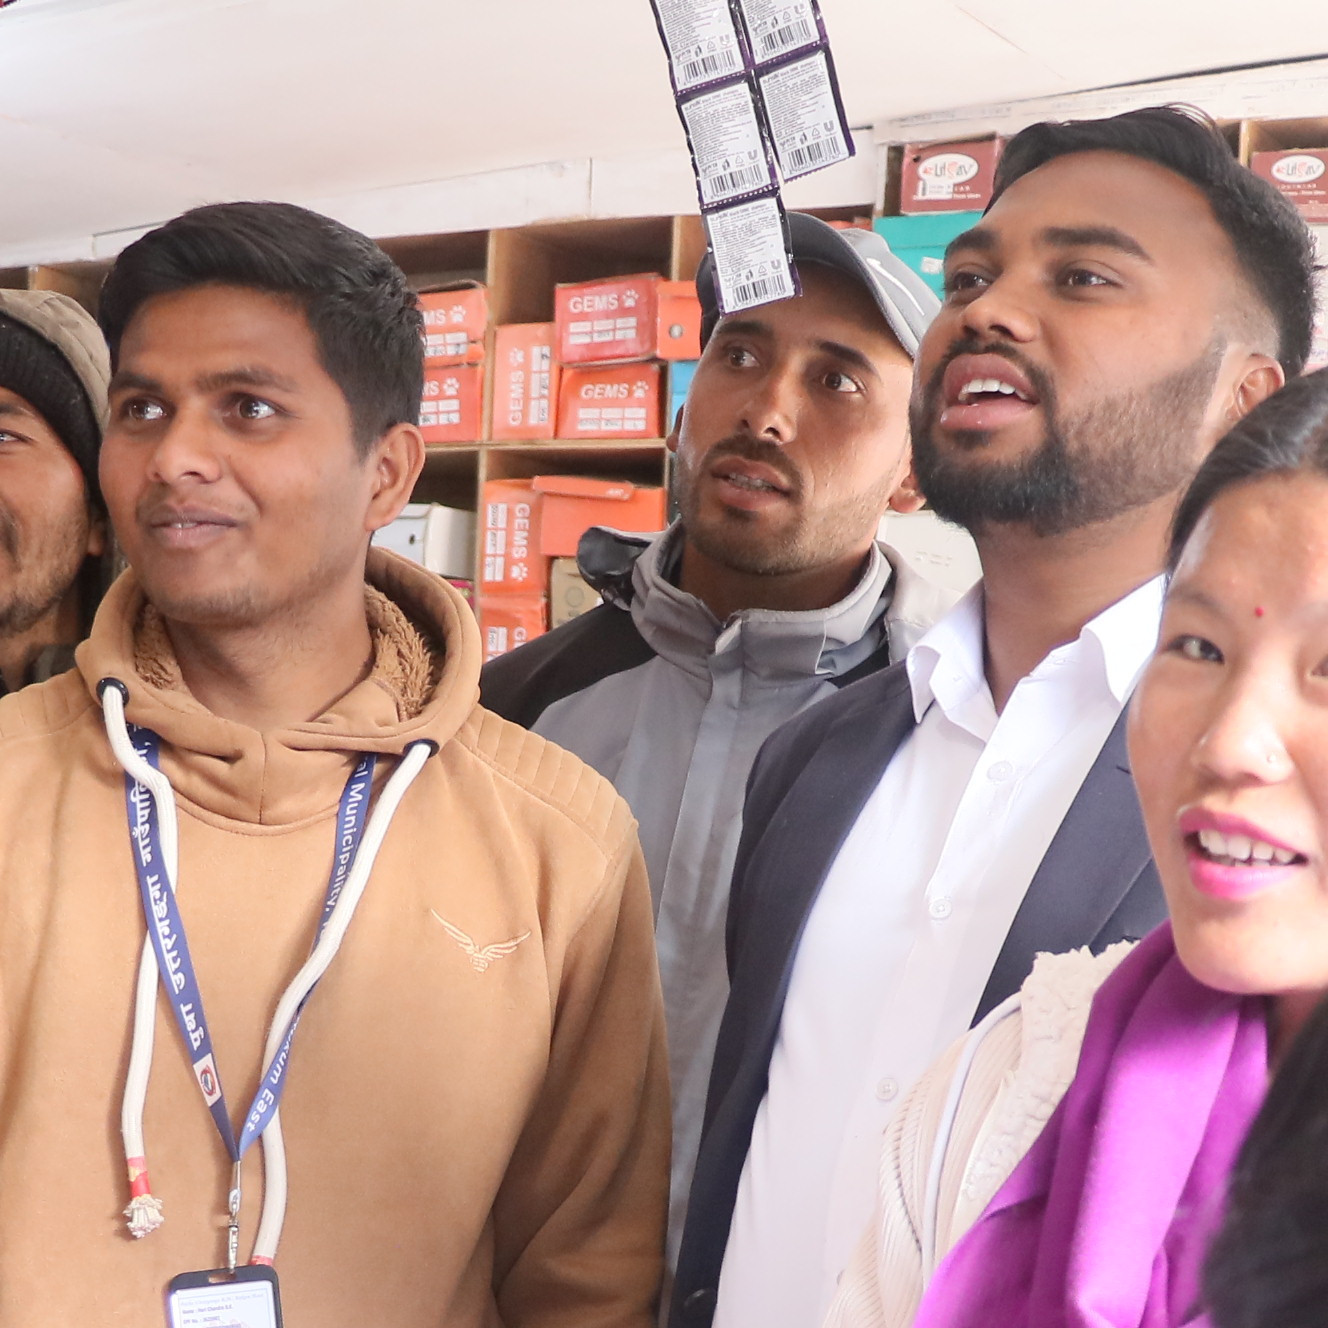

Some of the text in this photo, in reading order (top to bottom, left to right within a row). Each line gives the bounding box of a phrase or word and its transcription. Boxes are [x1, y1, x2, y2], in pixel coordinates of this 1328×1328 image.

[570, 293, 619, 313] GEMS
[508, 370, 525, 427] GEMS
[580, 383, 630, 400] GEMS
[511, 503, 531, 559] GEMS
[325, 780, 366, 914] Municipality,
[248, 1089, 275, 1133] East
